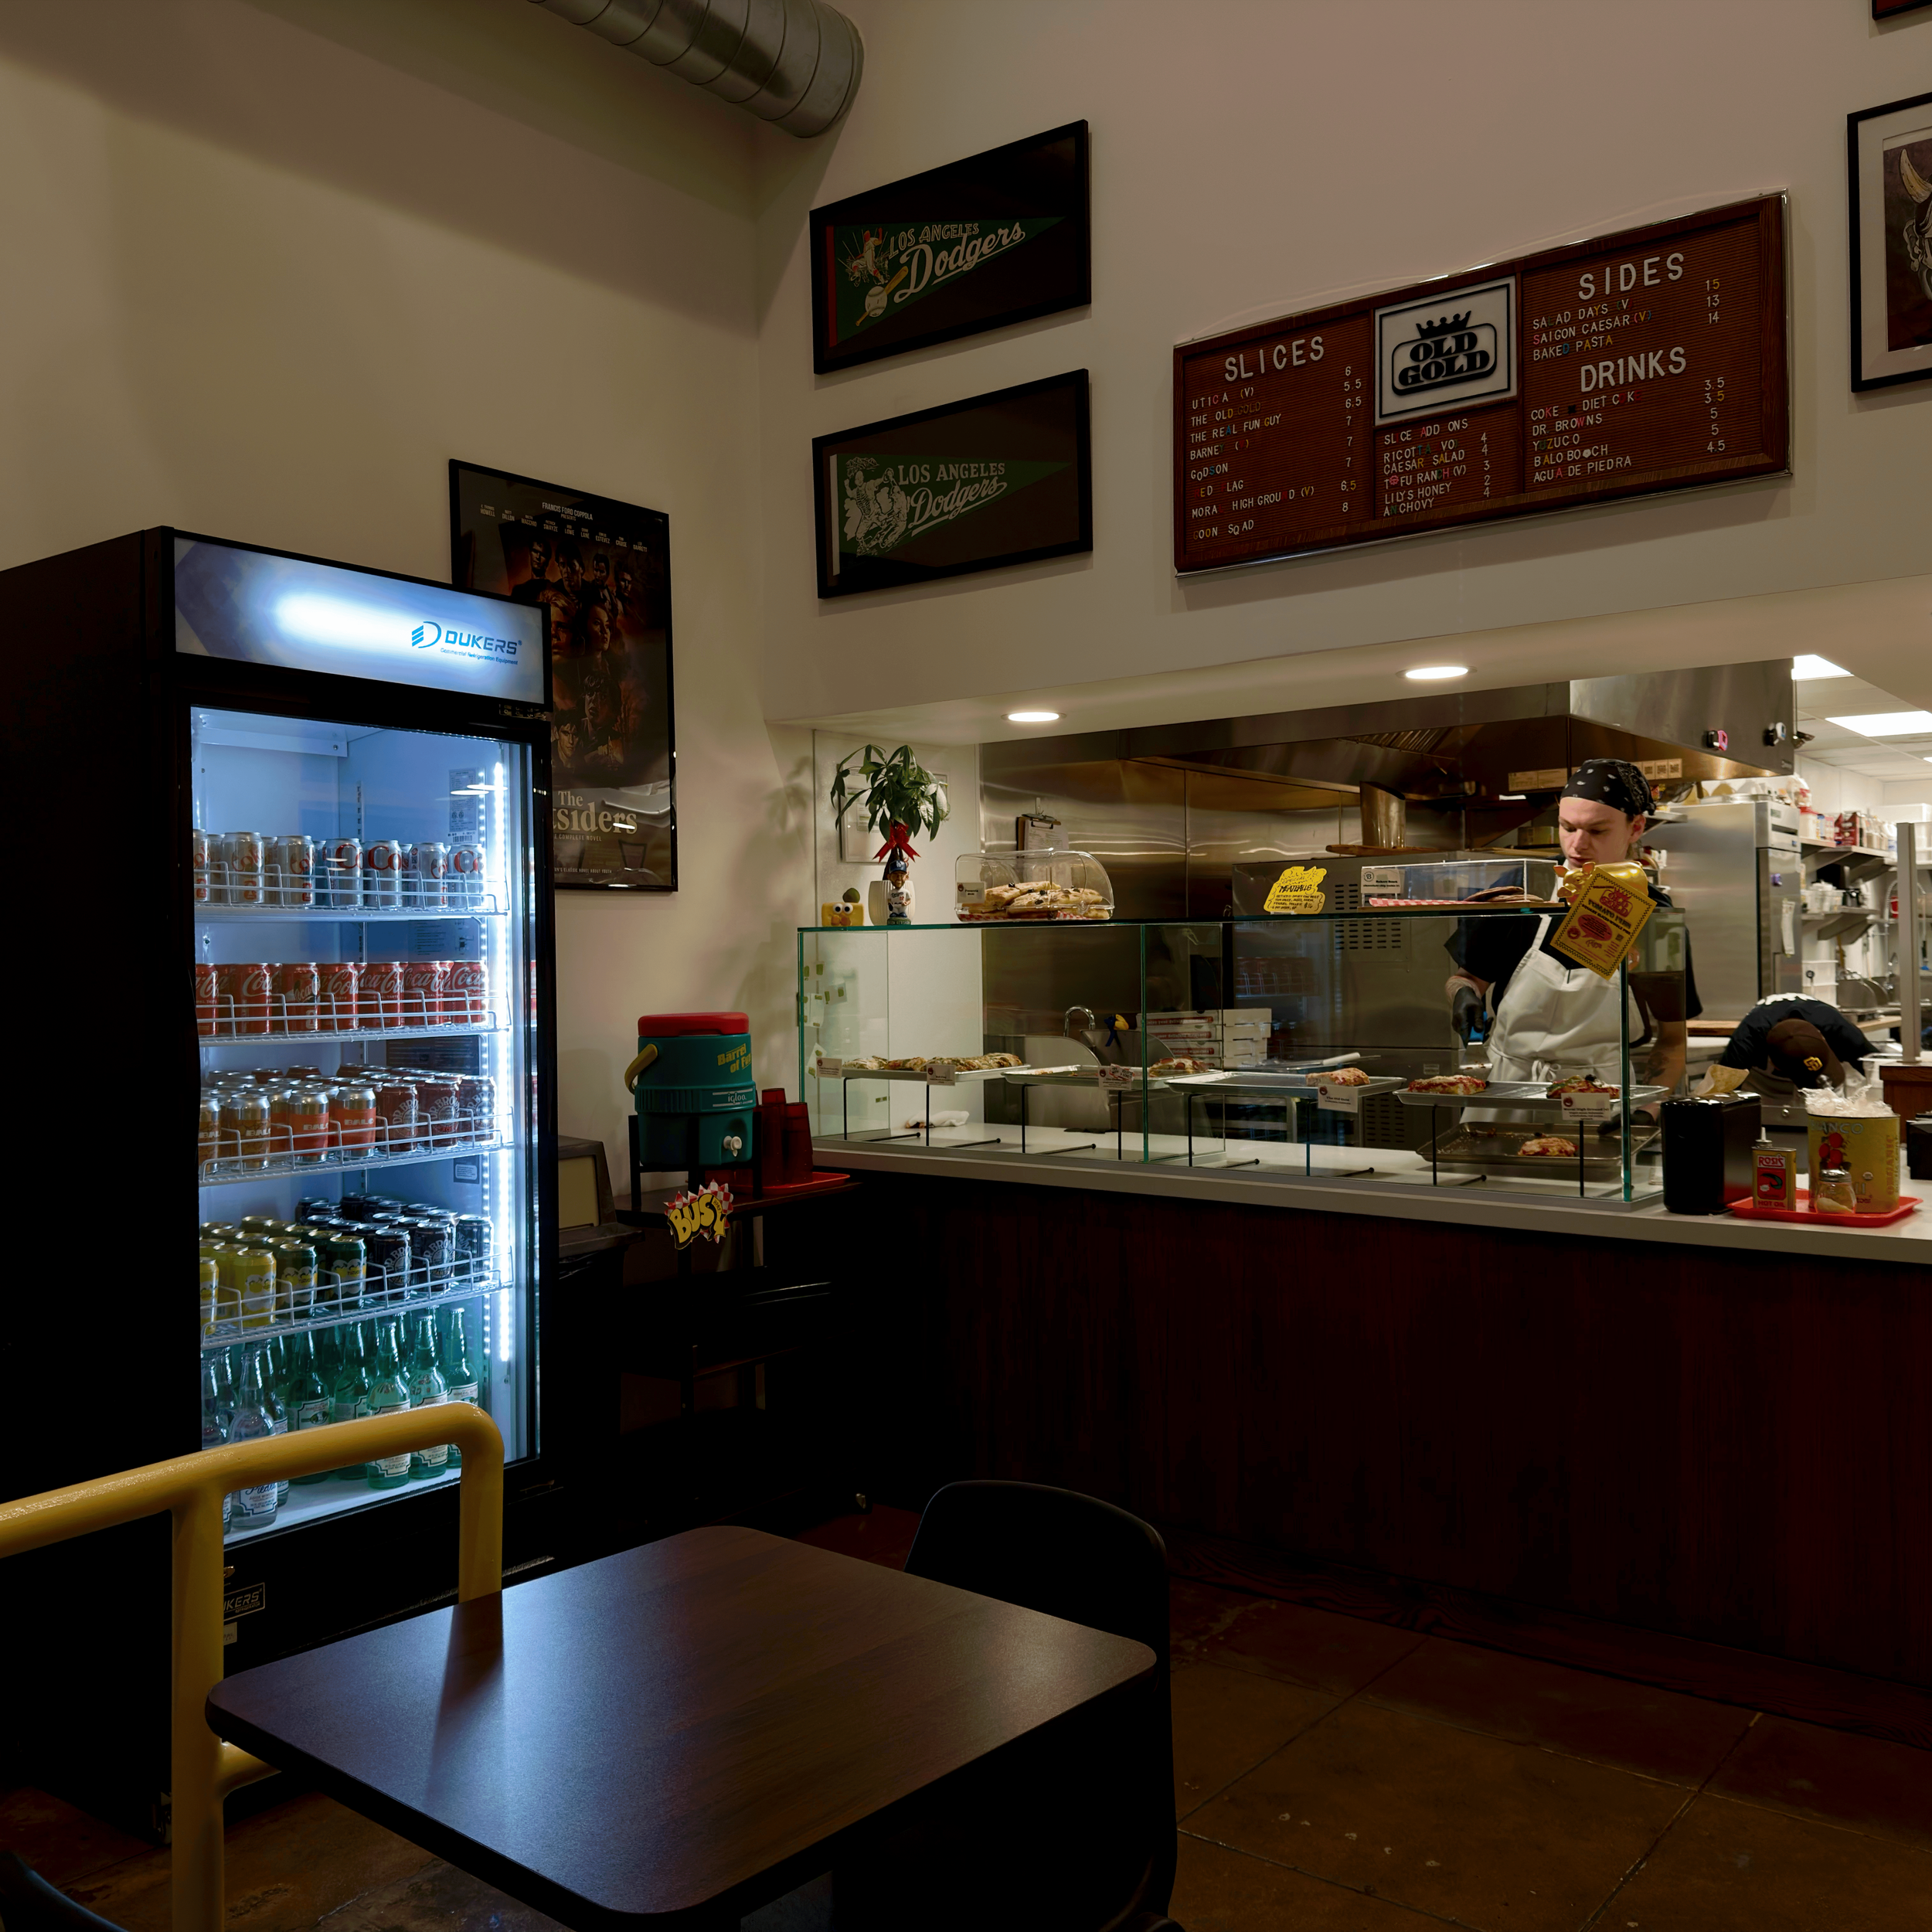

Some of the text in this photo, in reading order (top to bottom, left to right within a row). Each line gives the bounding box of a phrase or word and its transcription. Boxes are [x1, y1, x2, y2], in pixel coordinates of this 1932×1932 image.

[888, 223, 980, 260] LOS ANGELES
[893, 222, 1026, 304] Dodgers
[1578, 252, 1685, 300] SIDES
[1532, 311, 1571, 330] SALAD
[1578, 303, 1608, 320] DAYS
[1706, 278, 1720, 292] 15
[1533, 325, 1577, 345] SAIGON
[1581, 315, 1631, 335] CAESAR
[1706, 294, 1720, 308] 13
[1410, 332, 1478, 362] OLD
[1532, 311, 1720, 362] BAKED PASTA 14
[1224, 335, 1325, 382] SLICES
[1399, 350, 1490, 386] GOLD
[1580, 346, 1687, 393] DRINKS
[1191, 378, 1362, 427] THE OLD GOLD 5.5
[1192, 366, 1352, 410] UTICA (V) 6
[1530, 405, 1560, 421] COKE
[1582, 395, 1607, 411] DIET
[1704, 376, 1725, 391] 3.5
[1190, 396, 1362, 444] THE REAL FUN GUY 6.5
[1555, 412, 1603, 433] BROWNS
[1704, 389, 1725, 404] 3.5
[1190, 443, 1225, 461] BARNEY
[1345, 415, 1352, 427] 7
[1383, 418, 1469, 445] SLICE ADD ONS
[1532, 406, 1718, 452] YUZUCO 5
[1533, 451, 1563, 468] BALO
[1711, 423, 1719, 436] 5
[1190, 436, 1353, 481] GODSON 7
[1345, 457, 1352, 468] 7
[1383, 443, 1432, 464] RICOTTA
[1480, 431, 1488, 444] 4
[1383, 444, 1488, 475] CAESAR SALAD 4
[1533, 439, 1726, 484] AGUA DE PIEDRA 4.5
[897, 462, 1005, 485] LOS ANGELES
[1417, 467, 1451, 485] RANCH
[1452, 464, 1467, 477] (V)
[1483, 460, 1490, 471] 3
[906, 476, 1008, 536] Dodgers
[1232, 497, 1254, 511] HIGH
[1257, 488, 1296, 506] GROUND
[1300, 485, 1315, 498] (V)
[1340, 480, 1357, 492] 6.5
[1383, 486, 1491, 517] ANCHOVY 4
[1384, 474, 1491, 505] LILYS HONEY 2
[480, 508, 495, 518] HOWELL
[502, 513, 515, 522] DILLON
[542, 502, 594, 521] FRANCIS FORD COPPOLA
[1192, 526, 1219, 540] GOON
[1342, 502, 1349, 513] 8
[564, 527, 575, 536] LOWE
[580, 530, 590, 539] LANE
[595, 535, 611, 545] ESTEVEZ
[440, 648, 519, 665] Commercial Refrigeration Equipment
[445, 630, 518, 655] DUKERS
[558, 790, 583, 807] The
[1279, 884, 1313, 893] MEATBALLS
[717, 1043, 747, 1066] Barrel
[730, 1059, 740, 1073] of
[727, 1091, 747, 1105] igloo
[668, 1193, 726, 1246] BUSY
